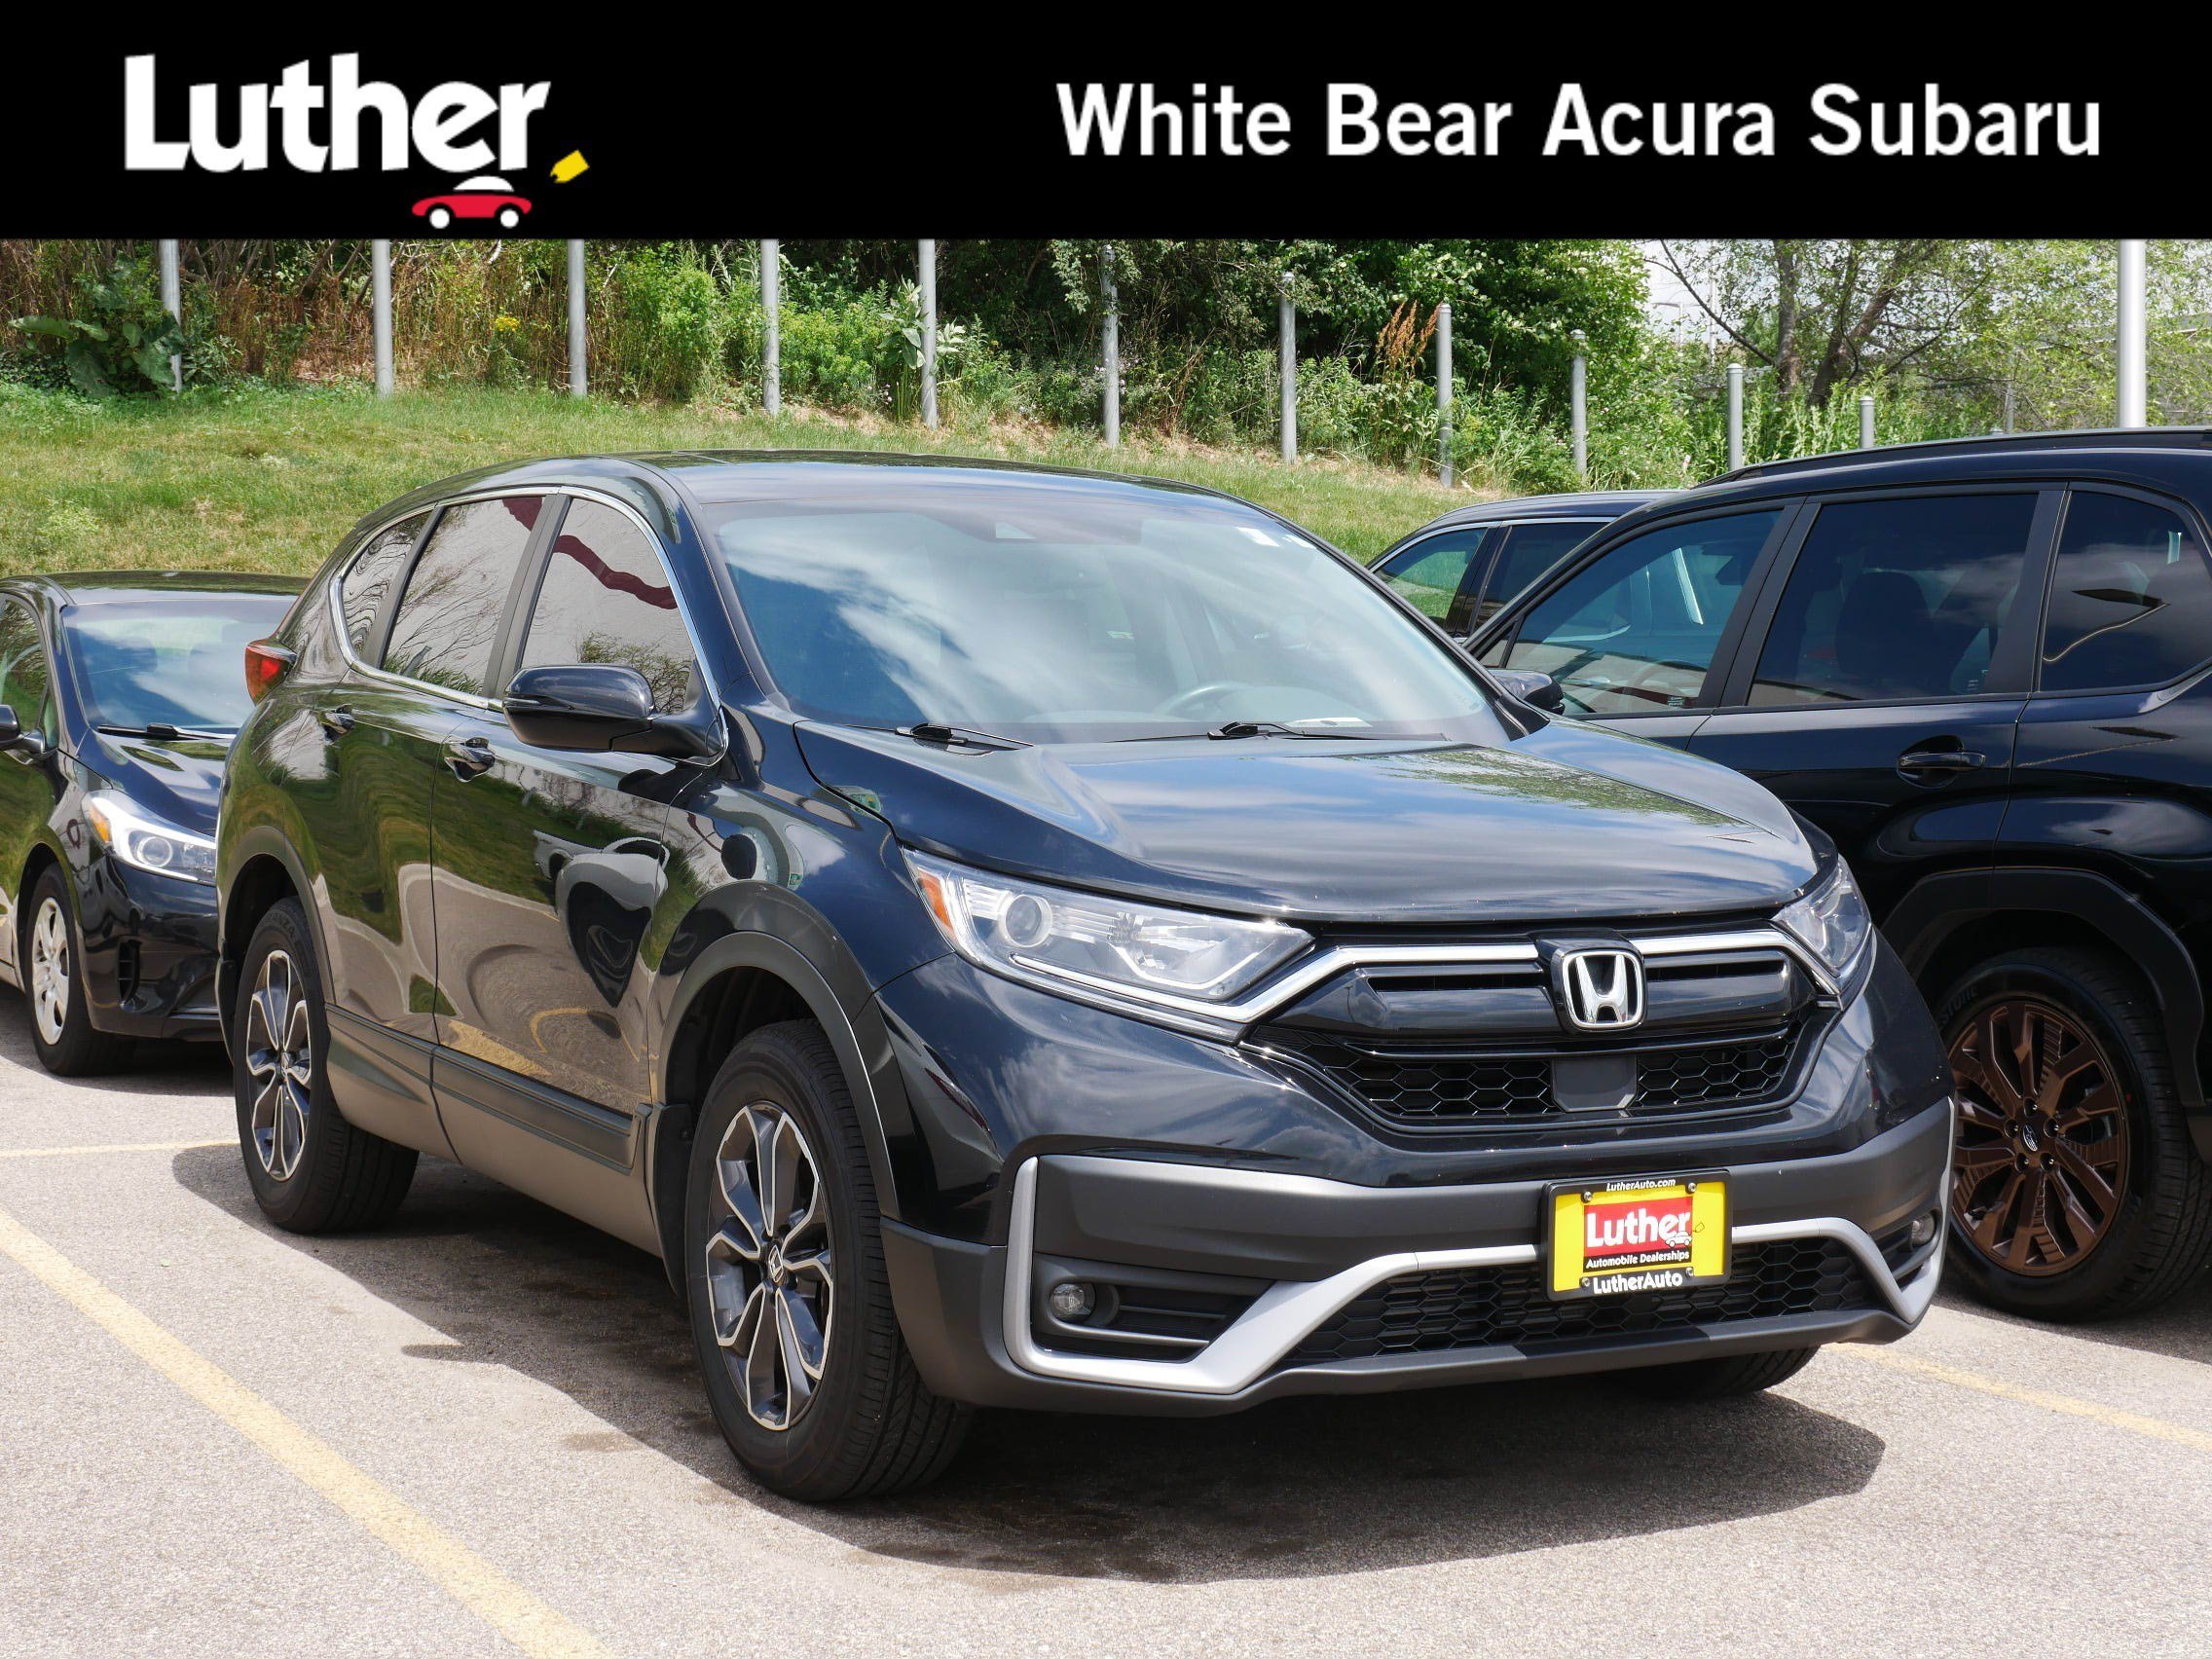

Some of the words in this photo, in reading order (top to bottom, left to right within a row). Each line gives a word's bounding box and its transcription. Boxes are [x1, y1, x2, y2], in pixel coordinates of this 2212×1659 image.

[1605, 1179, 1677, 1192] LutherAuto.com
[1586, 1207, 1691, 1248] Luther
[1585, 1254, 1638, 1270] Automobile
[1640, 1250, 1690, 1264] Dealerships
[1593, 1271, 1683, 1295] LutherAuto
